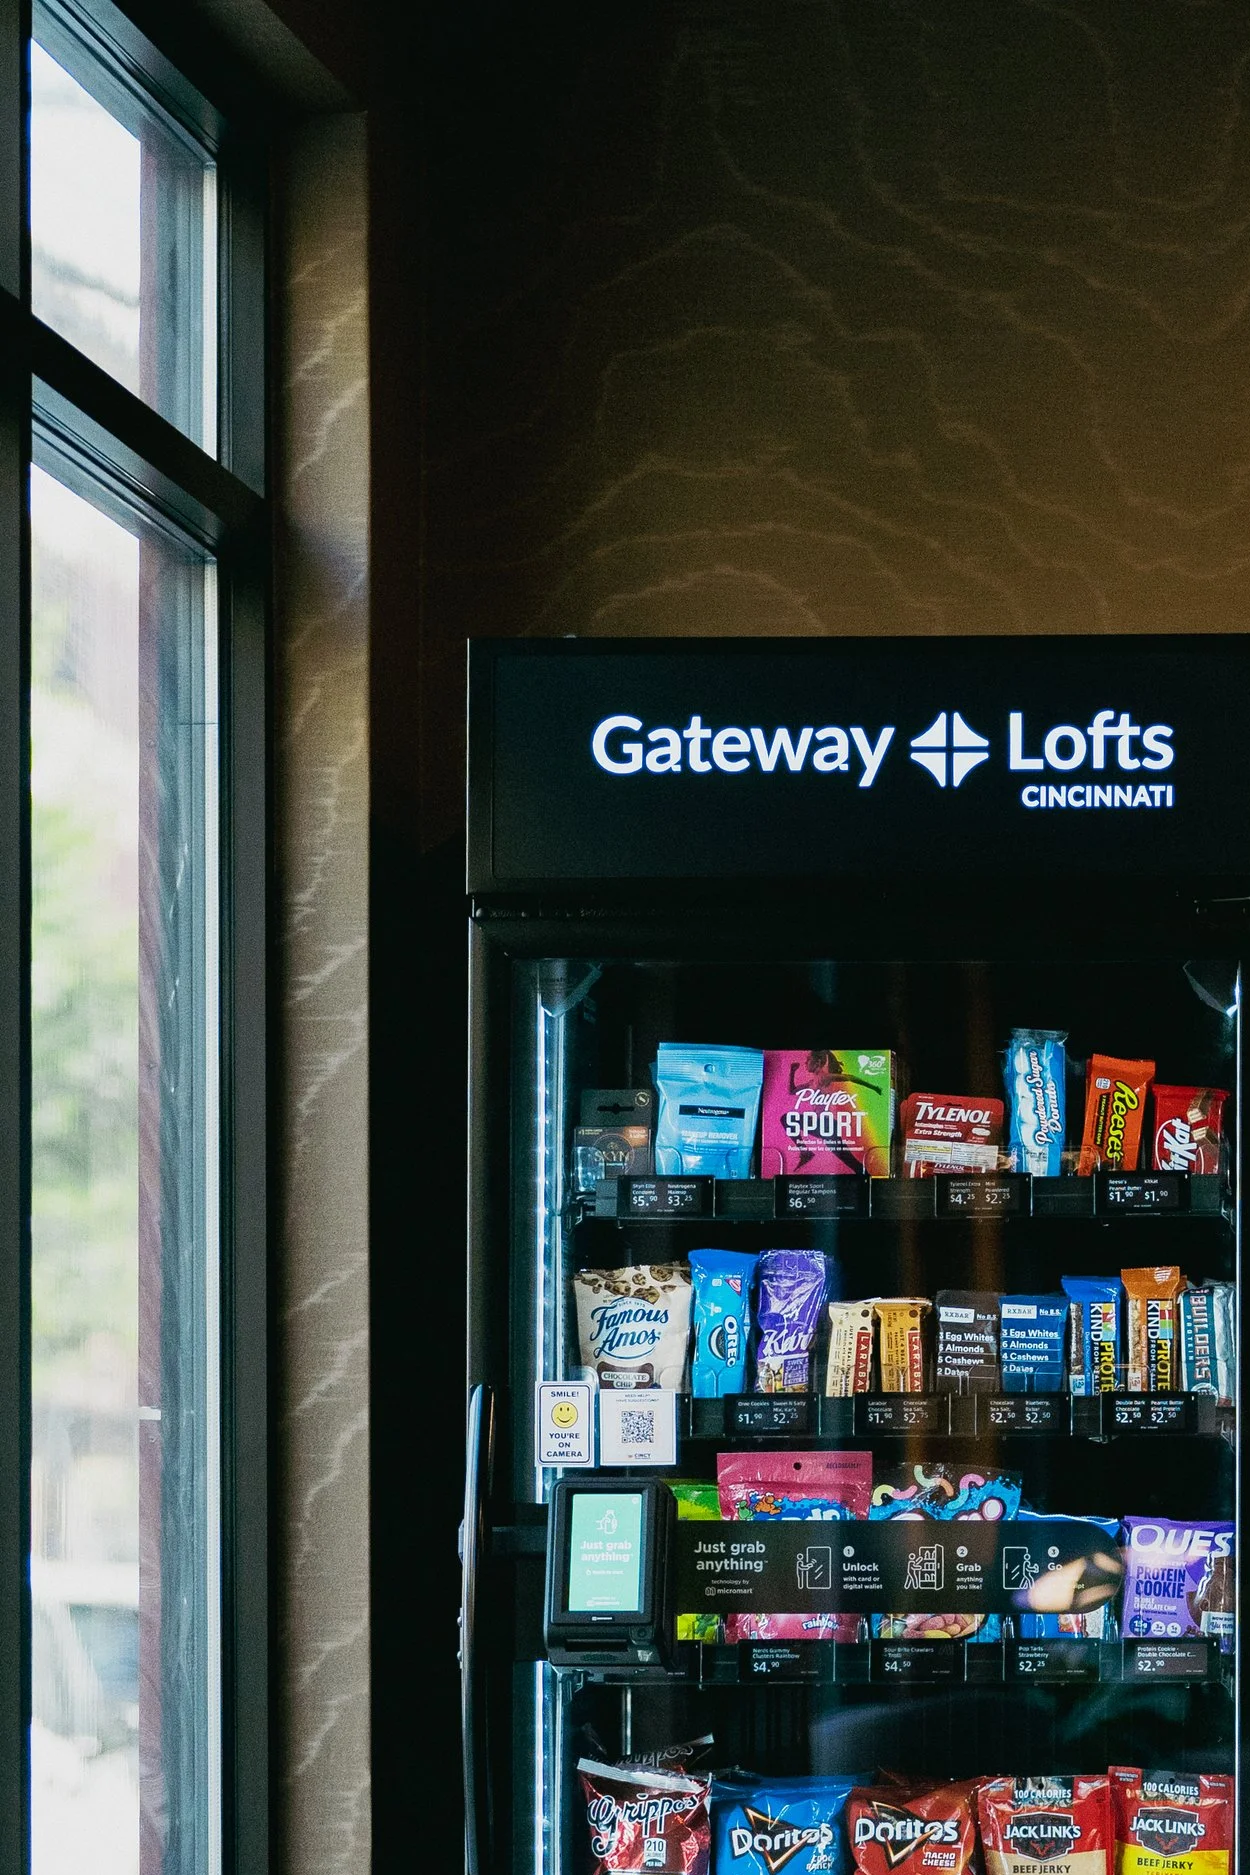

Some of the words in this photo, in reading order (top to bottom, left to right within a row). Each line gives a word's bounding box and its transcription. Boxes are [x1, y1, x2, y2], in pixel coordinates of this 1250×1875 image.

[592, 714, 895, 787] Gateway
[1009, 710, 1174, 771] Lofts
[1021, 785, 1173, 807] CINCINNATI
[1026, 1051, 1044, 1087] Sugar
[794, 1088, 858, 1111] Playtex
[915, 1102, 991, 1124] TYLENOL
[1047, 1080, 1063, 1134] Donuts
[1035, 1086, 1053, 1145] Powdered
[1106, 1080, 1139, 1163] Reese's
[785, 1111, 866, 1137] SPORT
[914, 1128, 931, 1136] Extra
[932, 1129, 962, 1138] Strength
[589, 1304, 670, 1341] Famous
[1090, 1303, 1103, 1342] KIND
[1147, 1300, 1160, 1339] KIND
[946, 1333, 961, 1342] Egg
[964, 1334, 994, 1342] Whites
[1002, 1329, 1008, 1337] 3
[1010, 1329, 1026, 1339] Egg
[1027, 1329, 1058, 1338] Whites
[1189, 1295, 1210, 1380] BUILDERS
[594, 1328, 661, 1360] Amos
[723, 1315, 740, 1368] OREO
[1010, 1341, 1048, 1349] Almonds
[946, 1344, 984, 1353] Almonds
[945, 1356, 984, 1365] Cashews
[1010, 1352, 1049, 1361] Cashews
[944, 1368, 970, 1376] Dates
[1010, 1364, 1034, 1373] Dates
[601, 1373, 648, 1381] CHOCOLATE
[550, 1390, 580, 1398] SMILE!
[549, 1432, 580, 1440] YOU'RE
[558, 1441, 571, 1449] ON
[546, 1450, 583, 1458] CAMERA
[694, 1540, 727, 1555] Just
[730, 1540, 766, 1556] grab
[1130, 1524, 1234, 1559] QUES
[696, 1558, 764, 1573] anything
[843, 1562, 879, 1572] Unlock
[956, 1563, 982, 1573] Grab
[1048, 1562, 1063, 1571] Go
[956, 1576, 983, 1584] anything
[1136, 1565, 1187, 1583] PROTEIN
[717, 1587, 753, 1595] micromart
[843, 1583, 862, 1591] digital
[1135, 1579, 1185, 1599] COOKIE
[1014, 1790, 1029, 1799] 100
[1030, 1789, 1072, 1800] CALORIES
[1143, 1782, 1158, 1792] 100
[1158, 1783, 1199, 1796] CALORIES
[1129, 1817, 1165, 1832] JACK
[855, 1818, 960, 1845] Doritos
[1003, 1824, 1039, 1839] JACK
[730, 1822, 834, 1861] Doritos
[924, 1851, 956, 1860] NACHO
[922, 1858, 956, 1868] CHEESE
[1013, 1865, 1038, 1874] BEEF
[1039, 1865, 1071, 1874] JERKY
[1137, 1857, 1161, 1867] BEEF
[1162, 1859, 1194, 1870] JERKY
